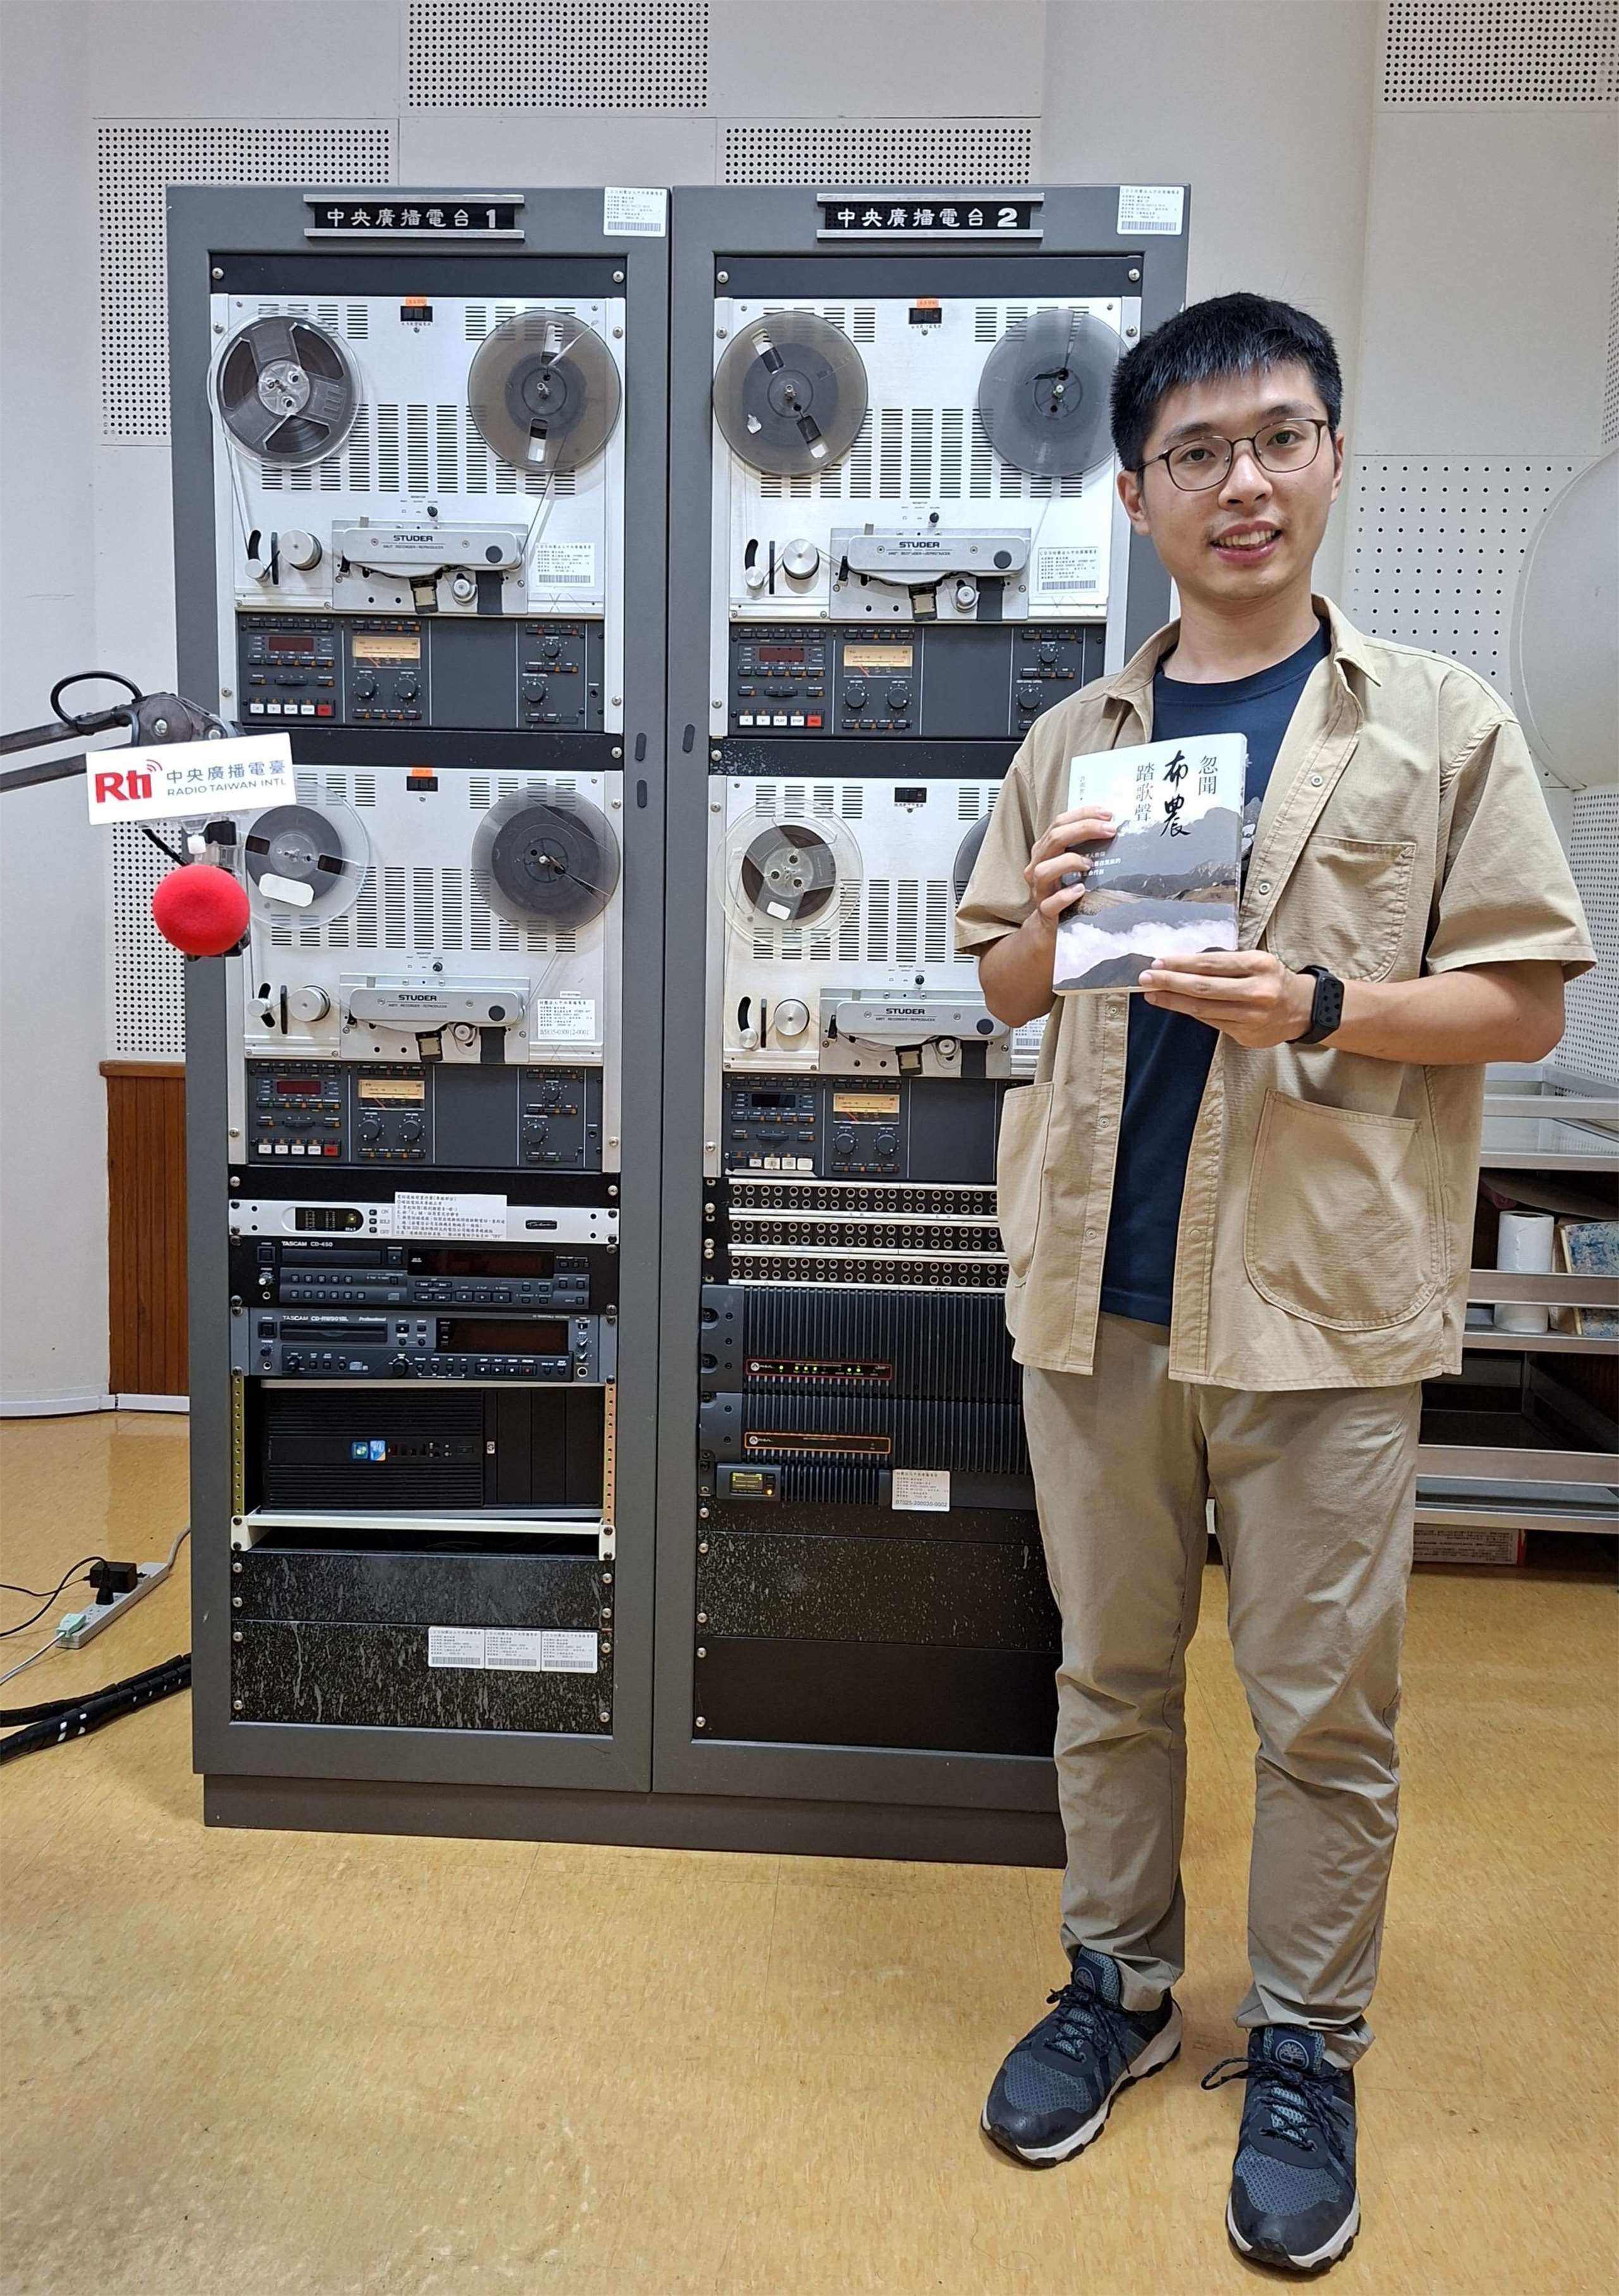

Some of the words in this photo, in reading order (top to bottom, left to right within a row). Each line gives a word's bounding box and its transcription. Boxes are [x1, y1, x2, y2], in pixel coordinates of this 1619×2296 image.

[327, 207, 469, 228] 中央廣播電台
[486, 209, 496, 228] 1
[837, 207, 983, 228] 中央廣播電台
[997, 207, 1018, 228] 2
[167, 760, 285, 784] 中央廣播電臺
[1198, 755, 1218, 796] 忽聞
[167, 785, 207, 796] RADIO
[210, 781, 257, 793] TAIWAN
[261, 777, 286, 787] INTL
[1135, 762, 1155, 822] 踏歌聲
[1160, 750, 1191, 837] 布農
